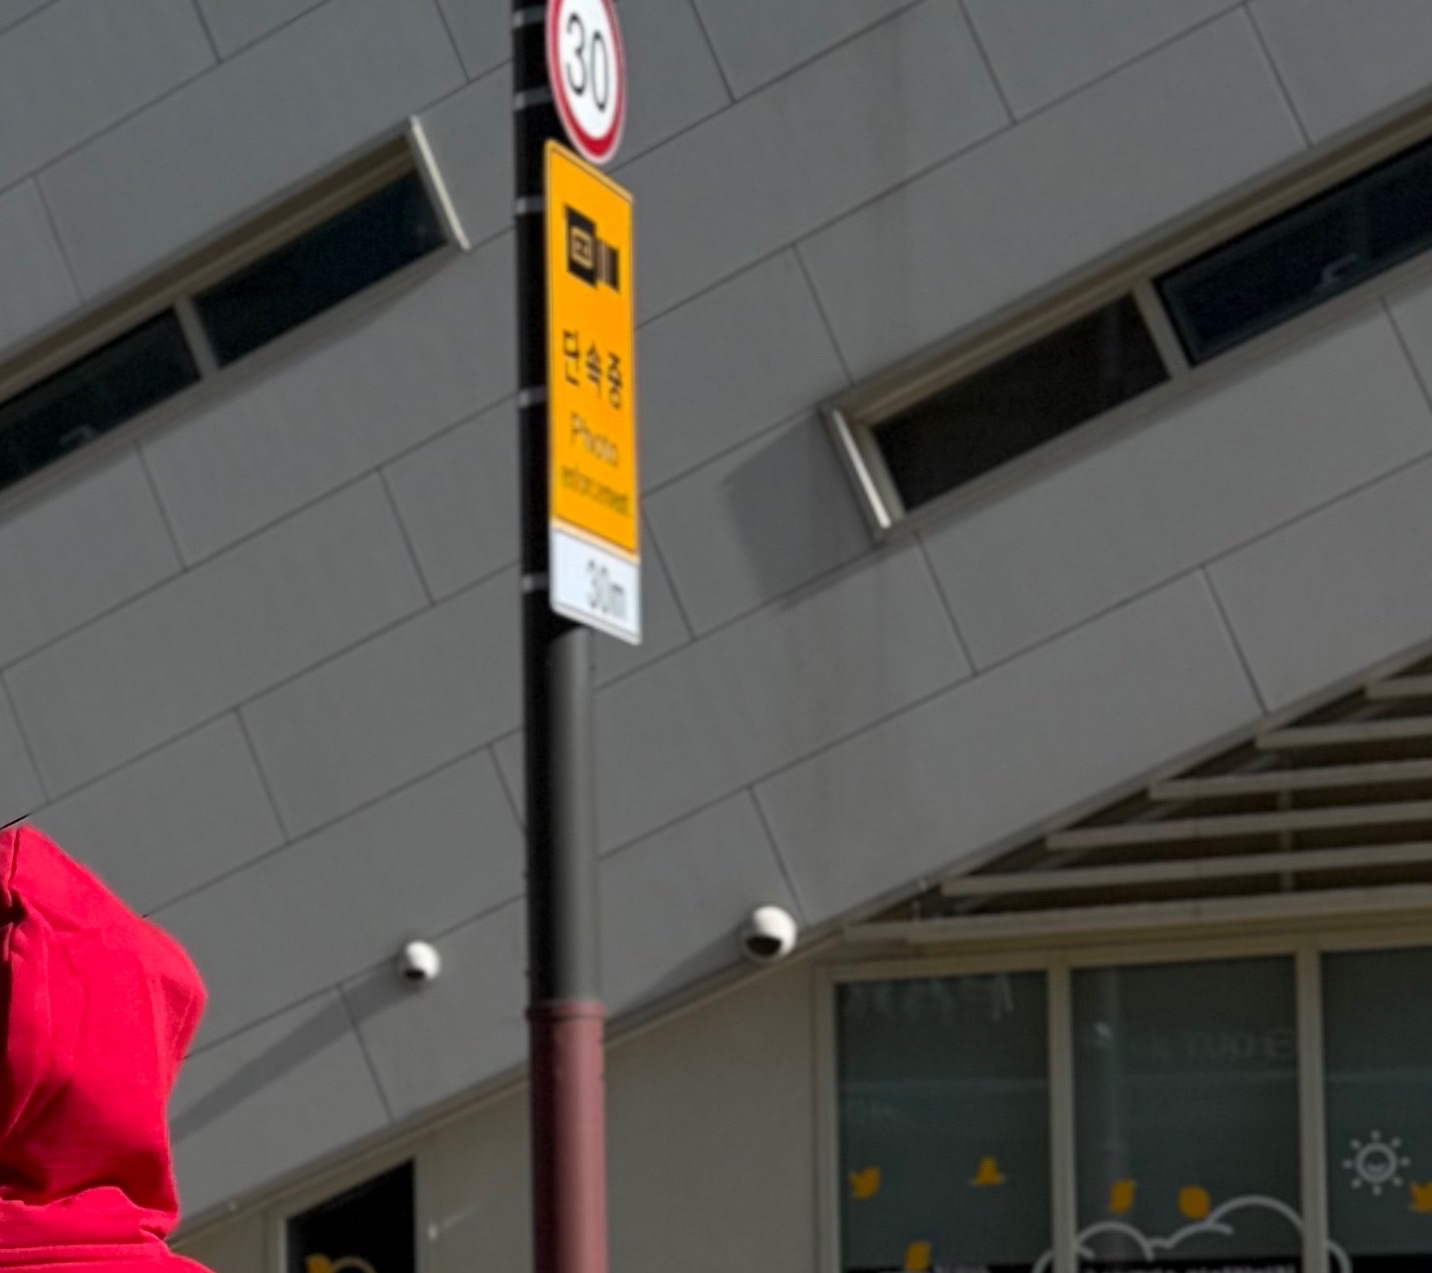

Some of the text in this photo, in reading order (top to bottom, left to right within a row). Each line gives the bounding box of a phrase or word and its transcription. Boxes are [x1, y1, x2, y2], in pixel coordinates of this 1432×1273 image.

[566, 12, 609, 113] 30
[562, 329, 623, 410] 단속중
[569, 411, 621, 469] Photo
[586, 560, 627, 620] 30m
